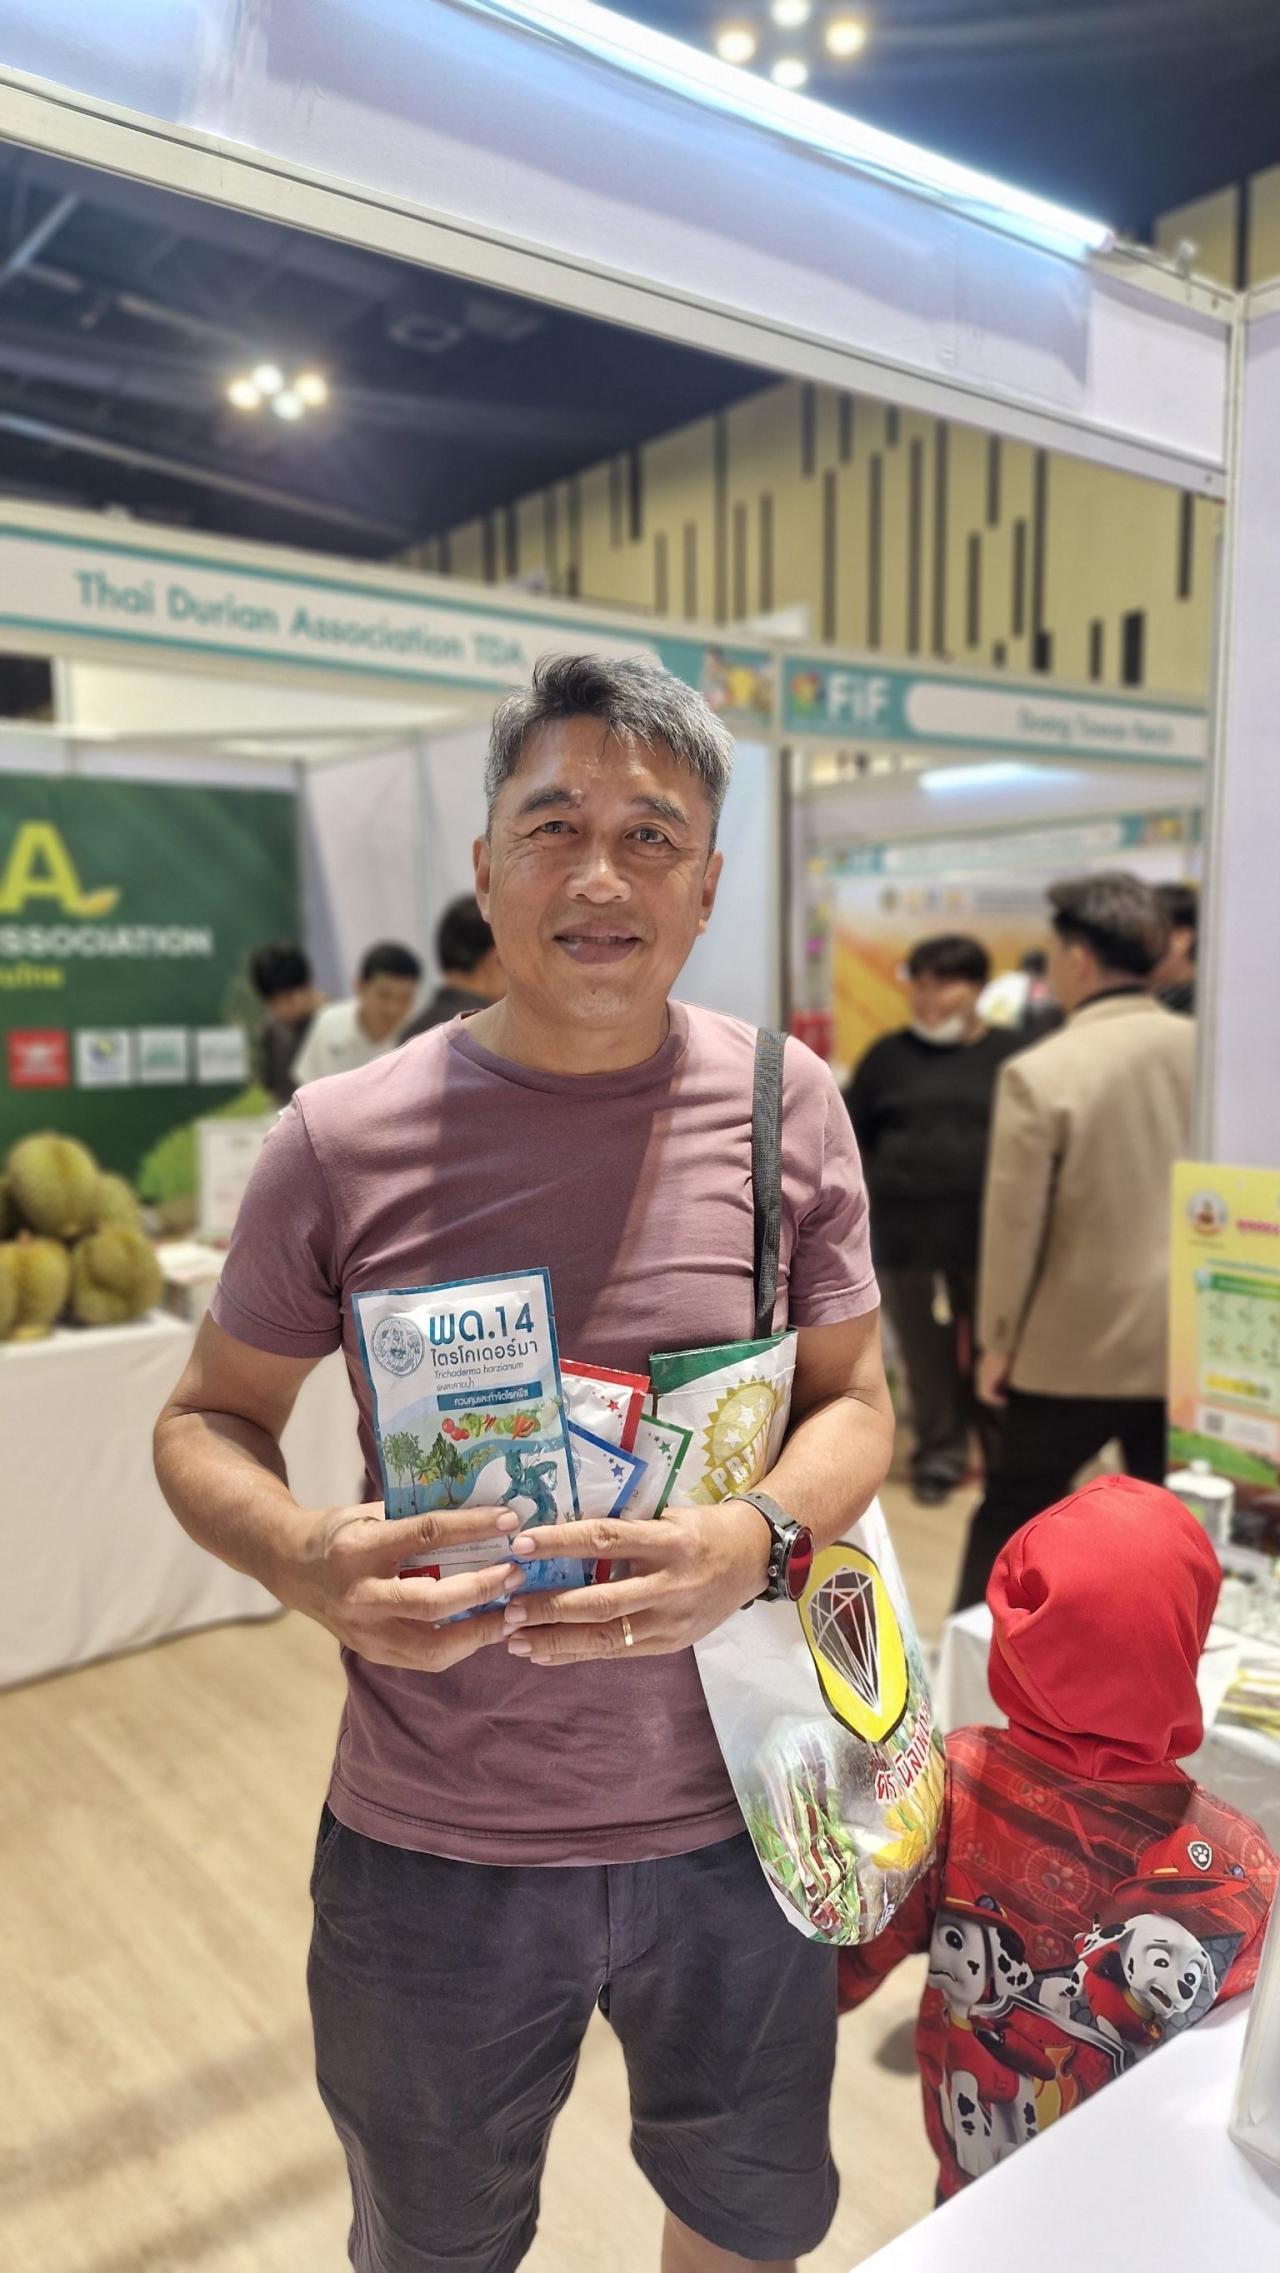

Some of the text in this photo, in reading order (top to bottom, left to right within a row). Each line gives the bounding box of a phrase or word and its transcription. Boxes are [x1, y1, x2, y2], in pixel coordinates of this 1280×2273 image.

[73, 569, 156, 615] Thai
[165, 584, 280, 633] Durian
[289, 605, 464, 659] Association
[0, 924, 212, 957] SSOCIATION
[430, 1338, 538, 1367] ไตรโคเดอร์มา
[434, 1361, 524, 1379] Trichoderma harzianum
